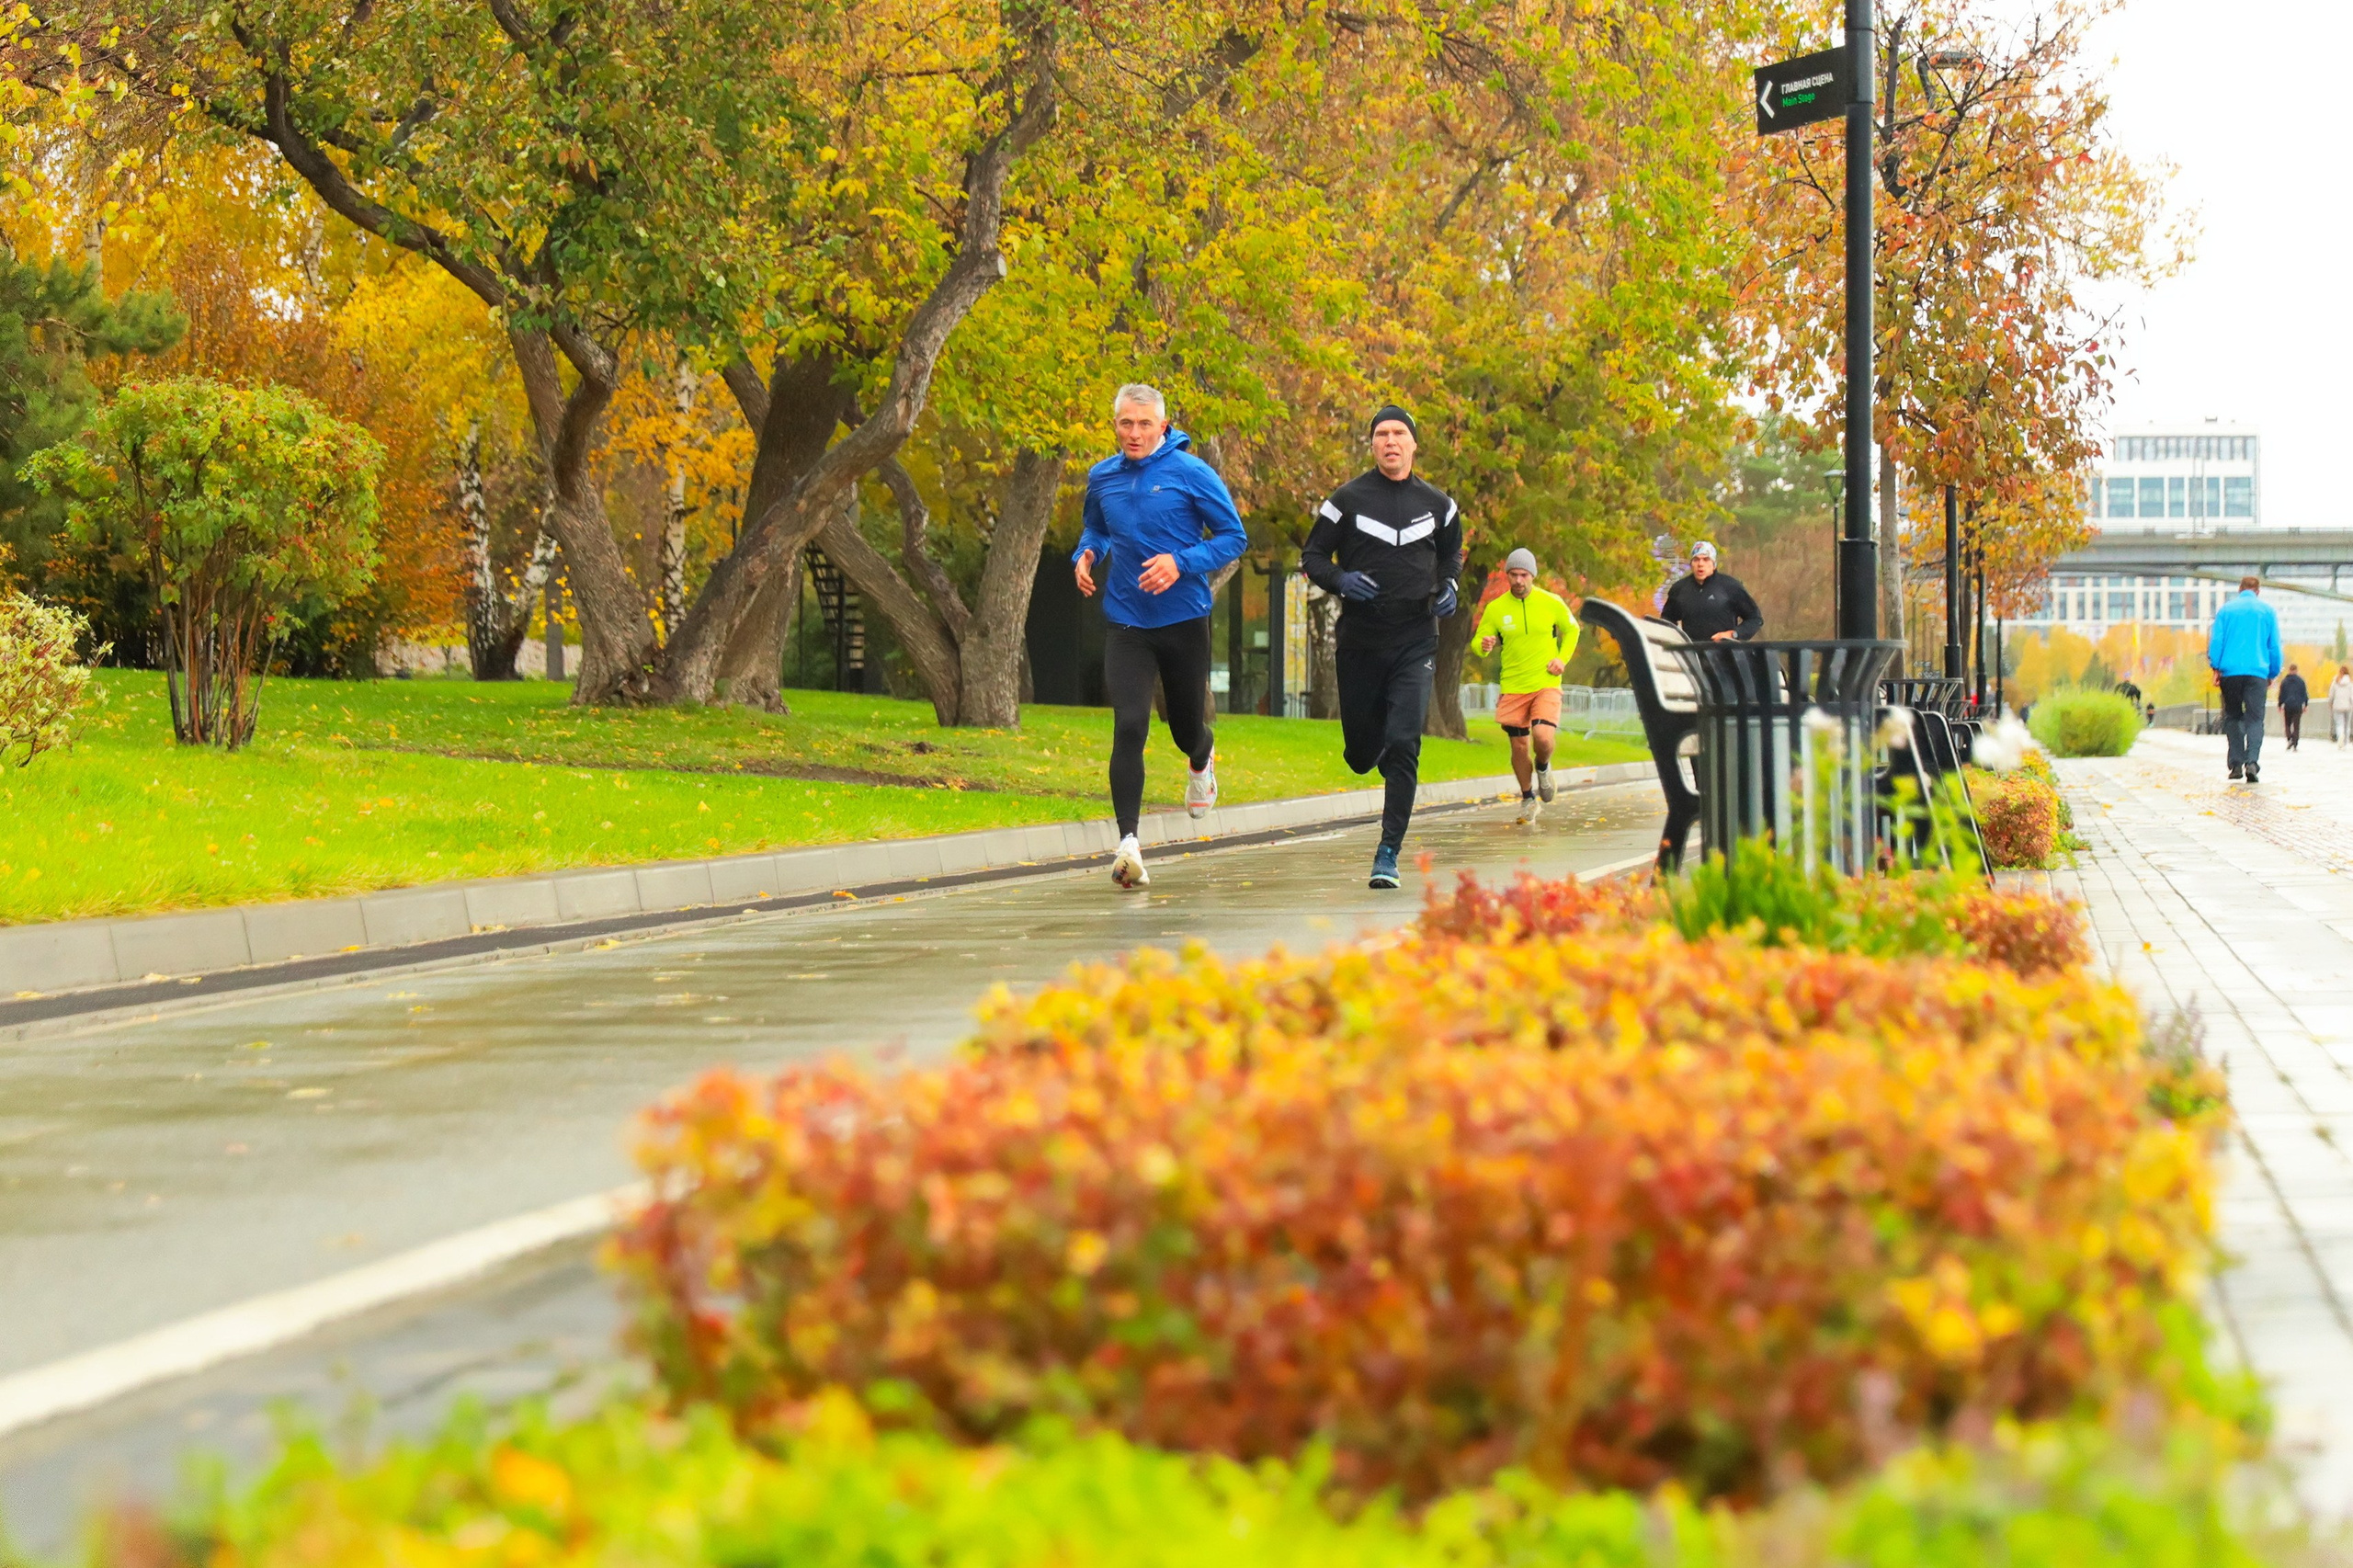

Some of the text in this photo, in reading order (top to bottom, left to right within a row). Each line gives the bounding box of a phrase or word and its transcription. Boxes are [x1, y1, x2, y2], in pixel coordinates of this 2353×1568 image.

[1781, 72, 1834, 95] ГЛАВНАЯ СЦЕНА
[1782, 93, 1815, 108] Main Stage
